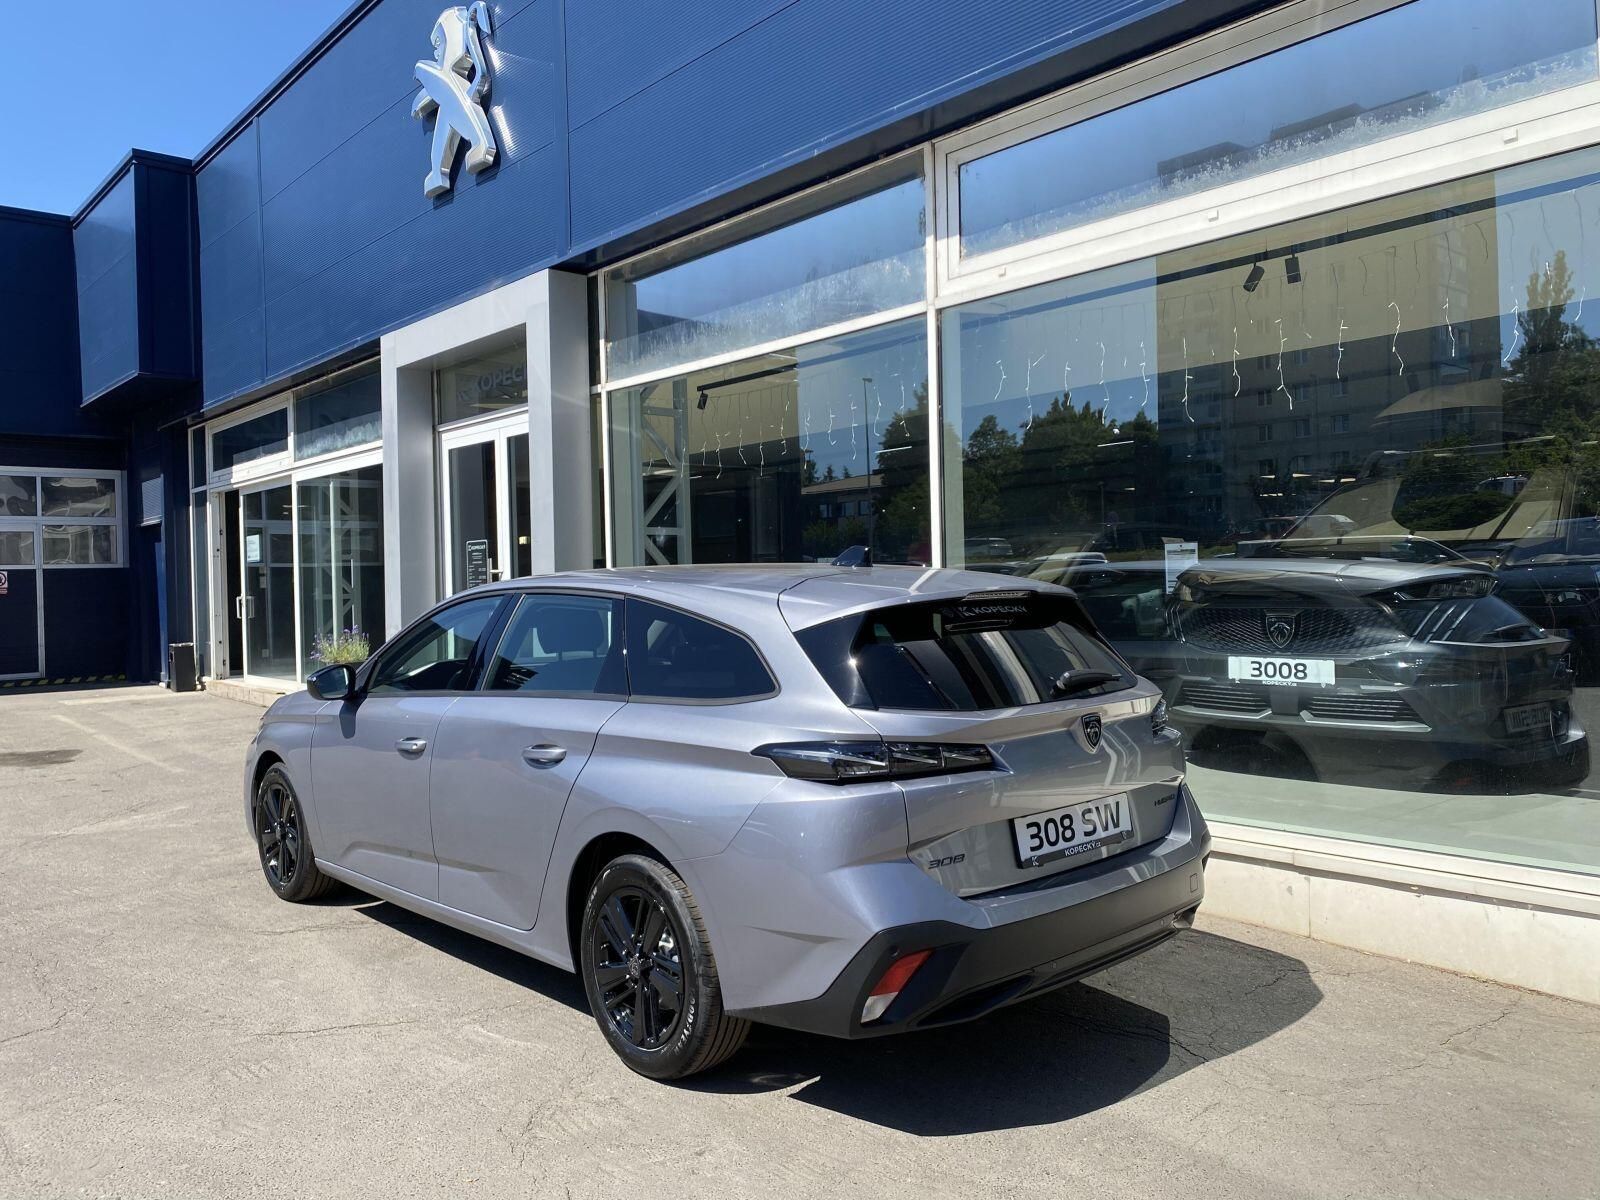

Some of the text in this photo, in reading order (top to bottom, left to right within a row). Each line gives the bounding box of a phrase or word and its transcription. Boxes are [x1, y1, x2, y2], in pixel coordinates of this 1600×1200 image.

[1250, 660, 1308, 680] 3008
[1025, 801, 1120, 852] 308 SW
[928, 853, 965, 870] 308
